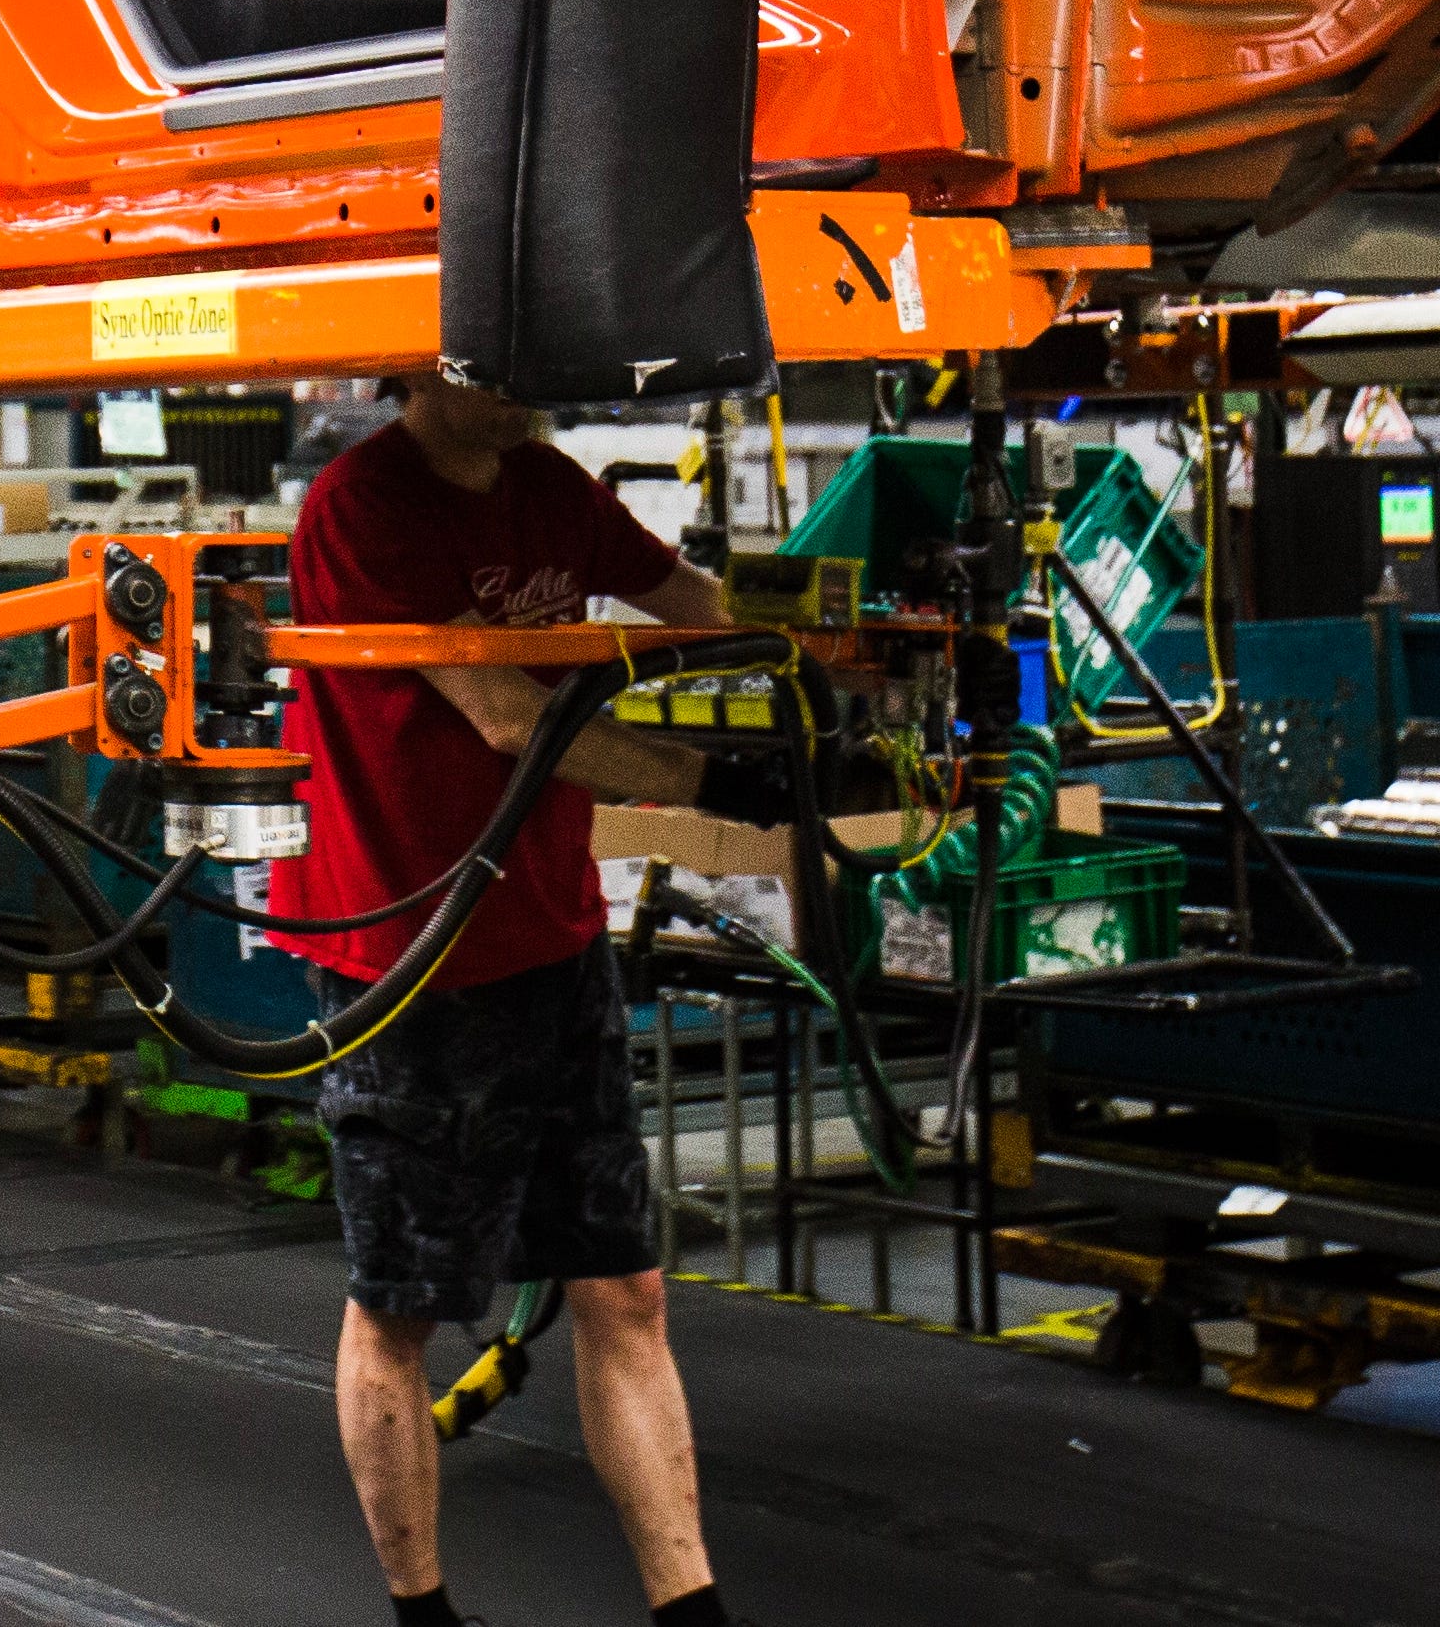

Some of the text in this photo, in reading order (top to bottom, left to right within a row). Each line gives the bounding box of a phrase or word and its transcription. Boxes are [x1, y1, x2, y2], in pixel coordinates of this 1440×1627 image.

[99, 296, 227, 348] Sync Optic Zone
